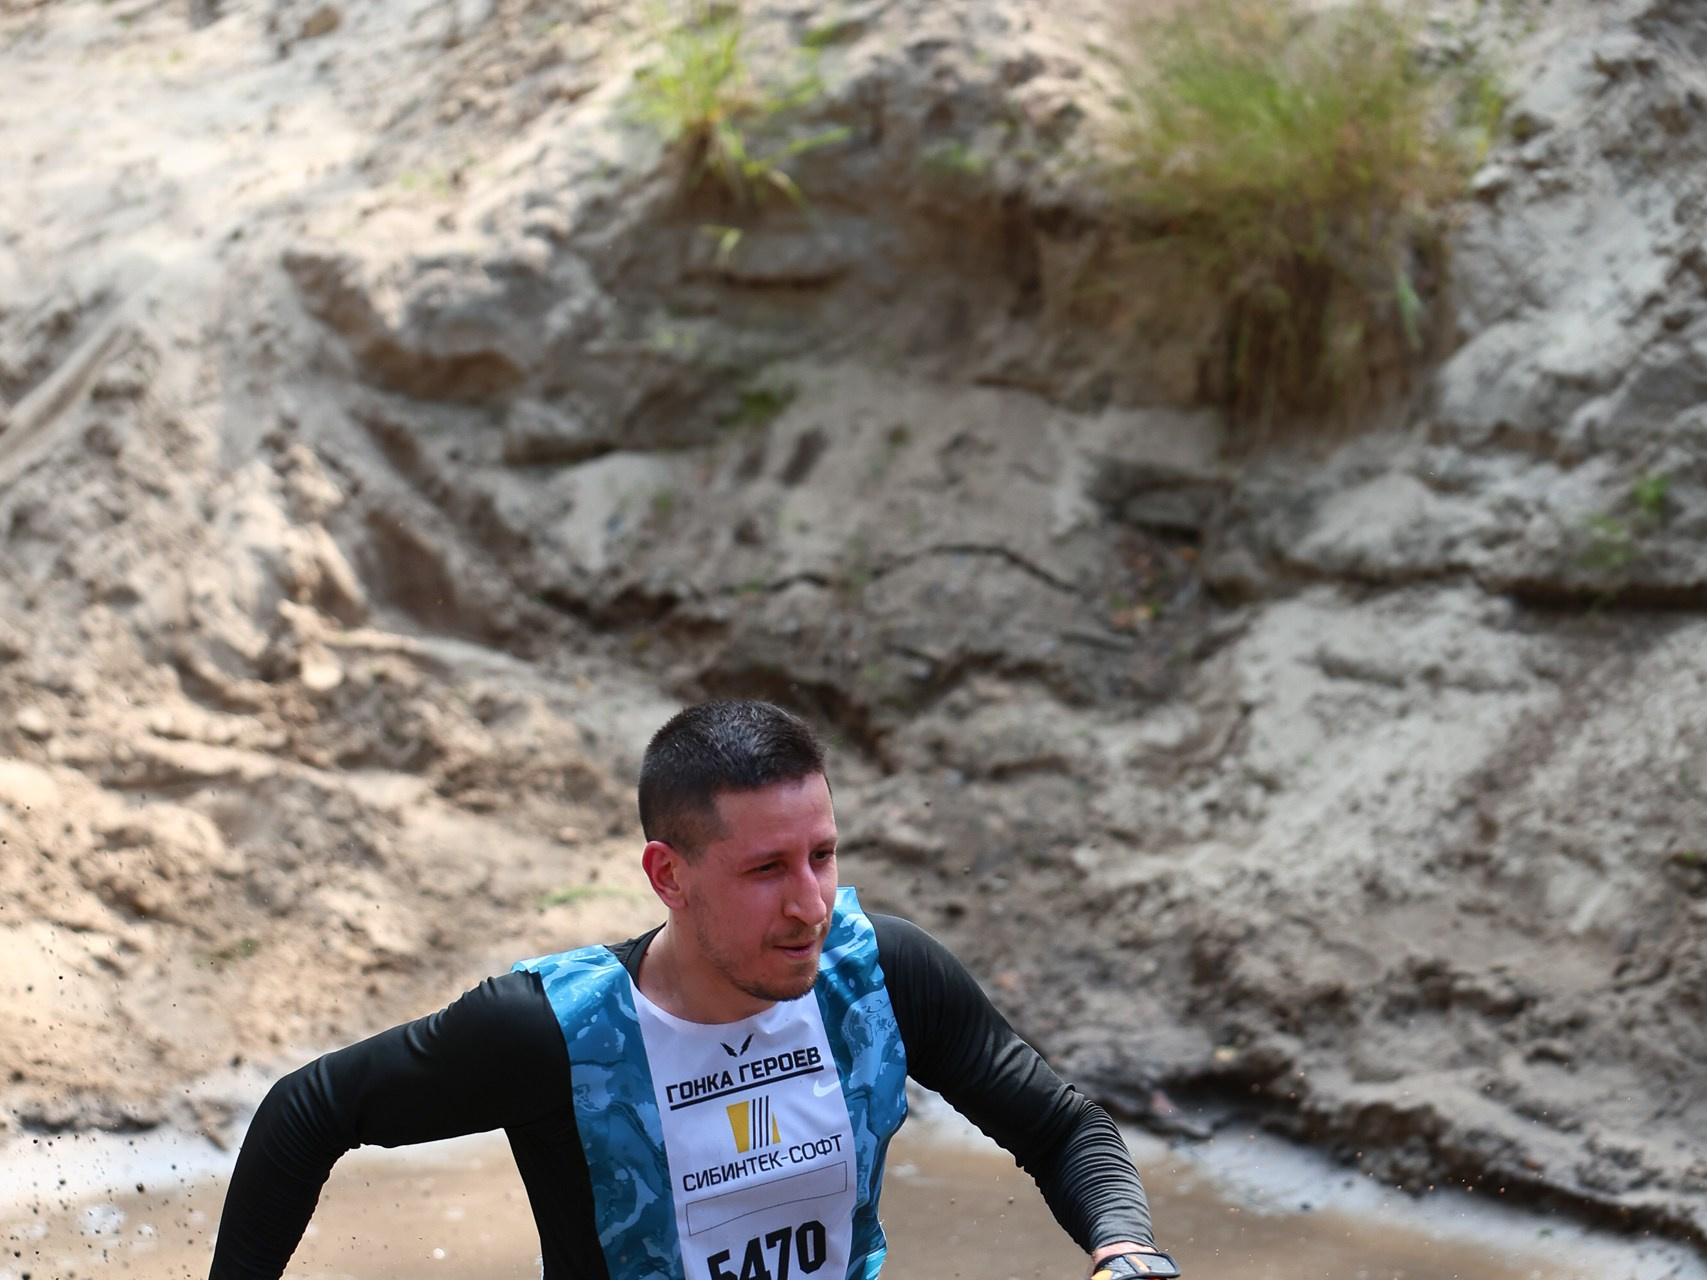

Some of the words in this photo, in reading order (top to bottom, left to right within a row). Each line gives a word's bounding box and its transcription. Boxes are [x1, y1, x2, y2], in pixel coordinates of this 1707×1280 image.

[665, 1069, 734, 1102] ГОНКА
[739, 1046, 822, 1083] ГЕРОЕВ
[683, 1134, 842, 1192] СИБИНТЕК-СОФТ
